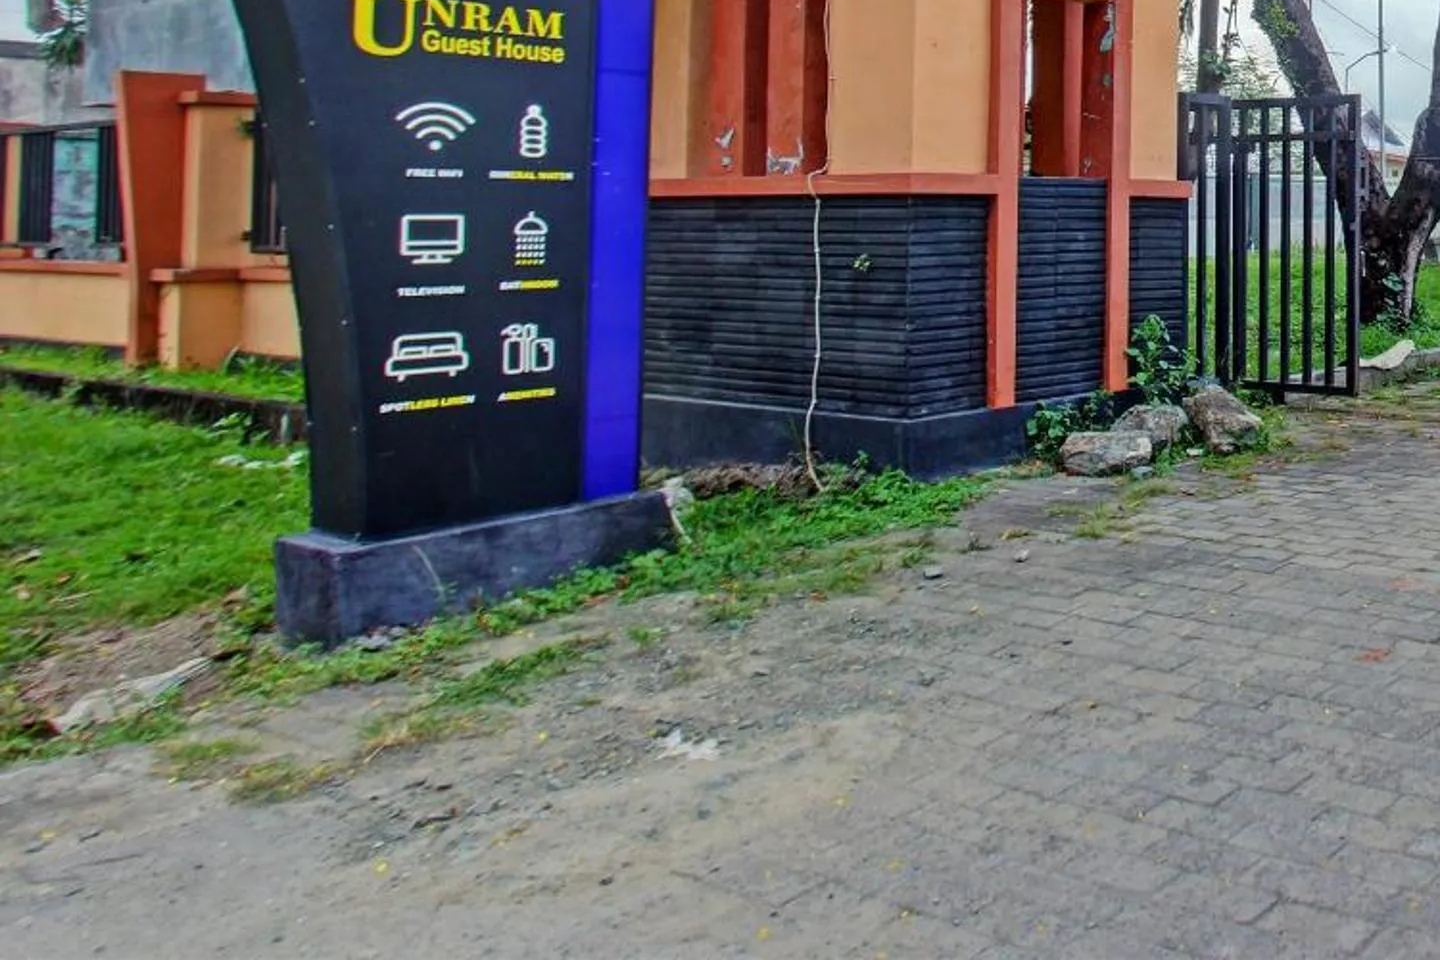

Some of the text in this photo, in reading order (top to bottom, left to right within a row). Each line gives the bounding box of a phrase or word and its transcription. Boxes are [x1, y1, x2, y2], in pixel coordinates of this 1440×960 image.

[421, 29, 565, 64] Guest House
[405, 168, 437, 178] FREE
[397, 285, 466, 297] TELEVISION
[379, 397, 440, 415] SPOTLESS
